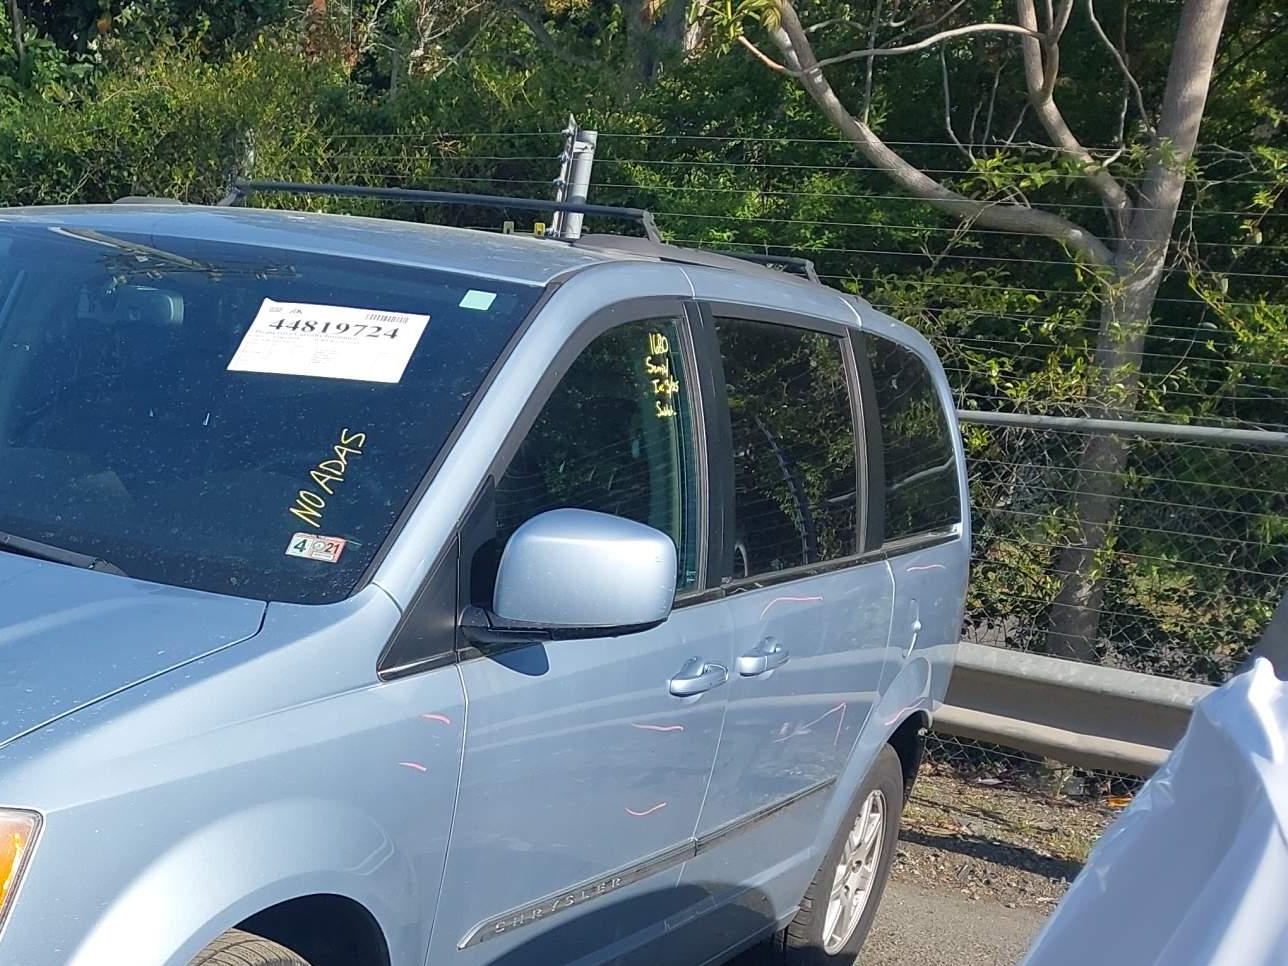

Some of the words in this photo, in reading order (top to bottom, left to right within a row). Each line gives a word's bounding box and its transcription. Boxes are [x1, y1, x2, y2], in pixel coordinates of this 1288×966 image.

[268, 318, 400, 340] 44819724
[289, 490, 326, 528] NO
[310, 428, 366, 494] ADAS
[293, 539, 308, 553] 4
[324, 542, 340, 554] 21
[495, 877, 622, 934] CHRYSLER
